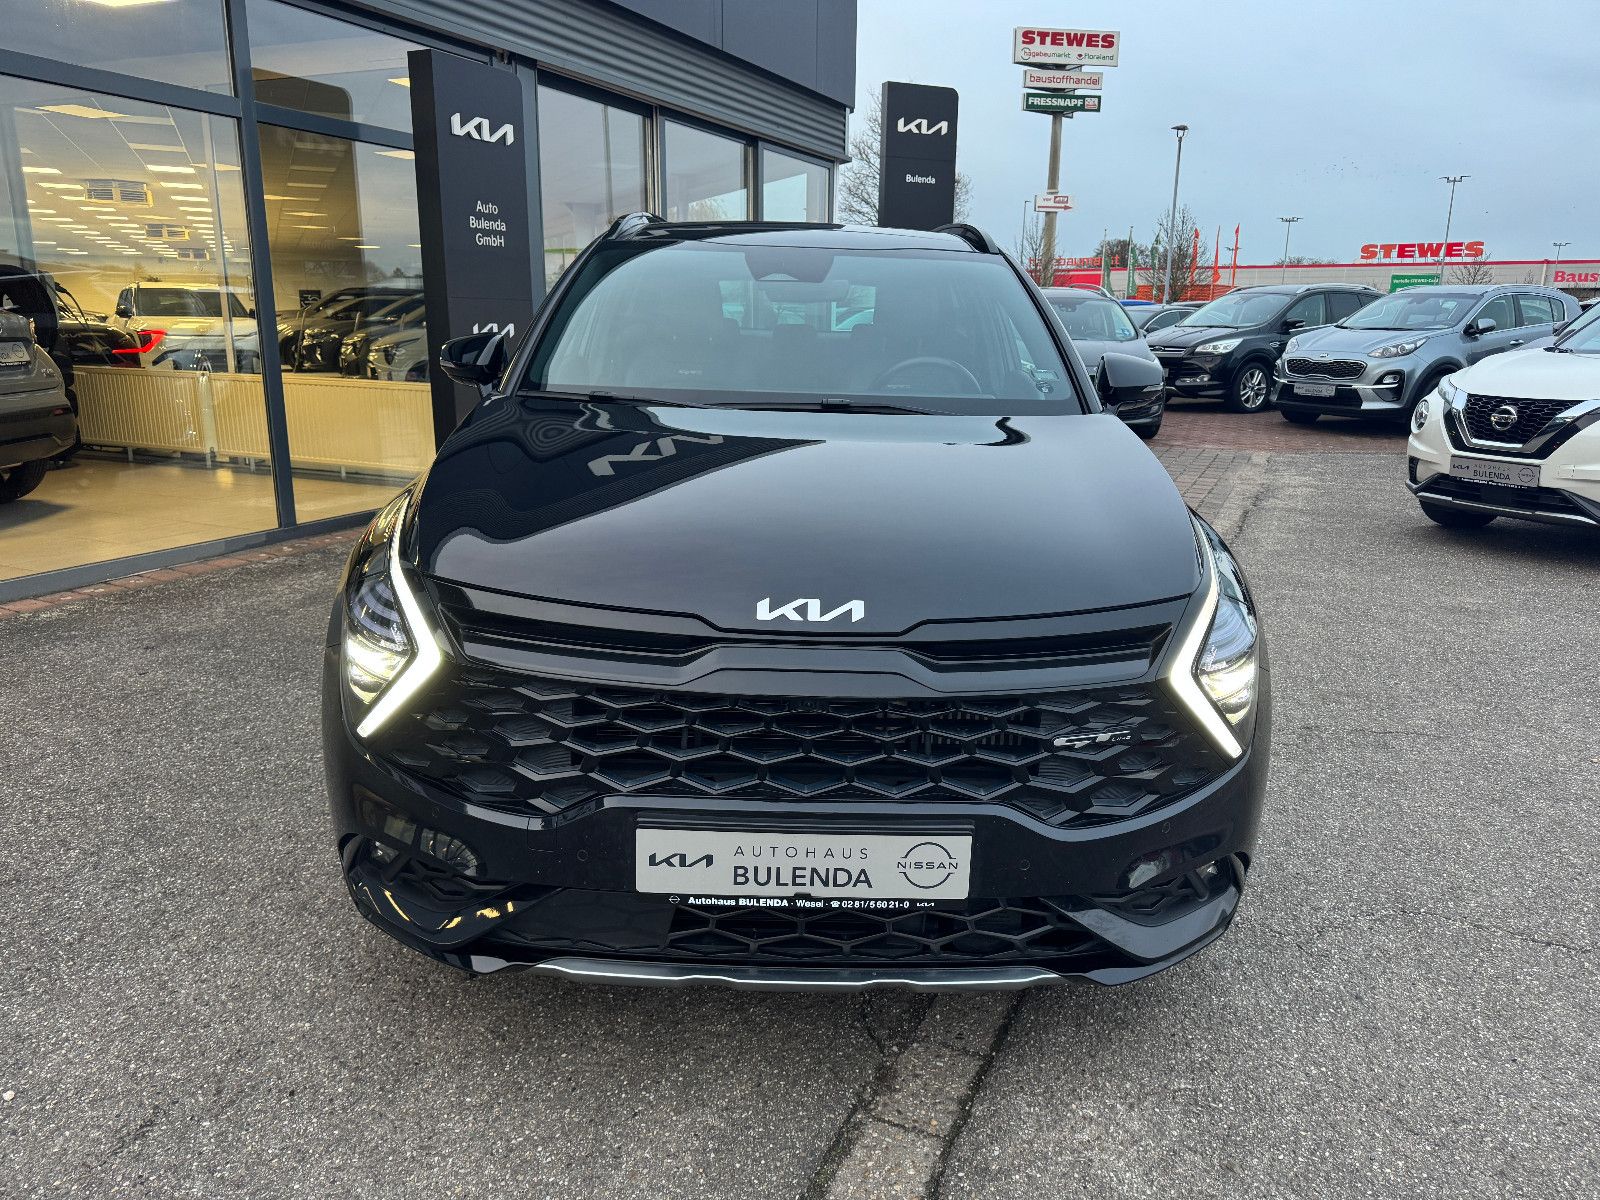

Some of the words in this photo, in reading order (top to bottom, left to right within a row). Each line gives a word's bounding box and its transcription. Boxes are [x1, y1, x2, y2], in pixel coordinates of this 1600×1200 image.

[1021, 30, 1115, 48] STEWES
[1029, 74, 1100, 86] baustoffhandel
[1028, 97, 1083, 107] FRESSNAPF
[905, 174, 936, 184] Bulenda
[476, 200, 499, 215] Auto
[469, 215, 506, 232] Bulenda
[475, 233, 505, 247] GmbH
[1360, 240, 1485, 260] STEWES
[1473, 469, 1511, 481] BULENDA
[756, 597, 865, 623] KIA
[733, 846, 869, 860] AUTOHAUS
[896, 860, 959, 871] NISSAN
[733, 865, 873, 889] BULENDA
[687, 896, 736, 906] Autohaus
[738, 898, 789, 907] BULENDA
[795, 899, 824, 908] Wesel
